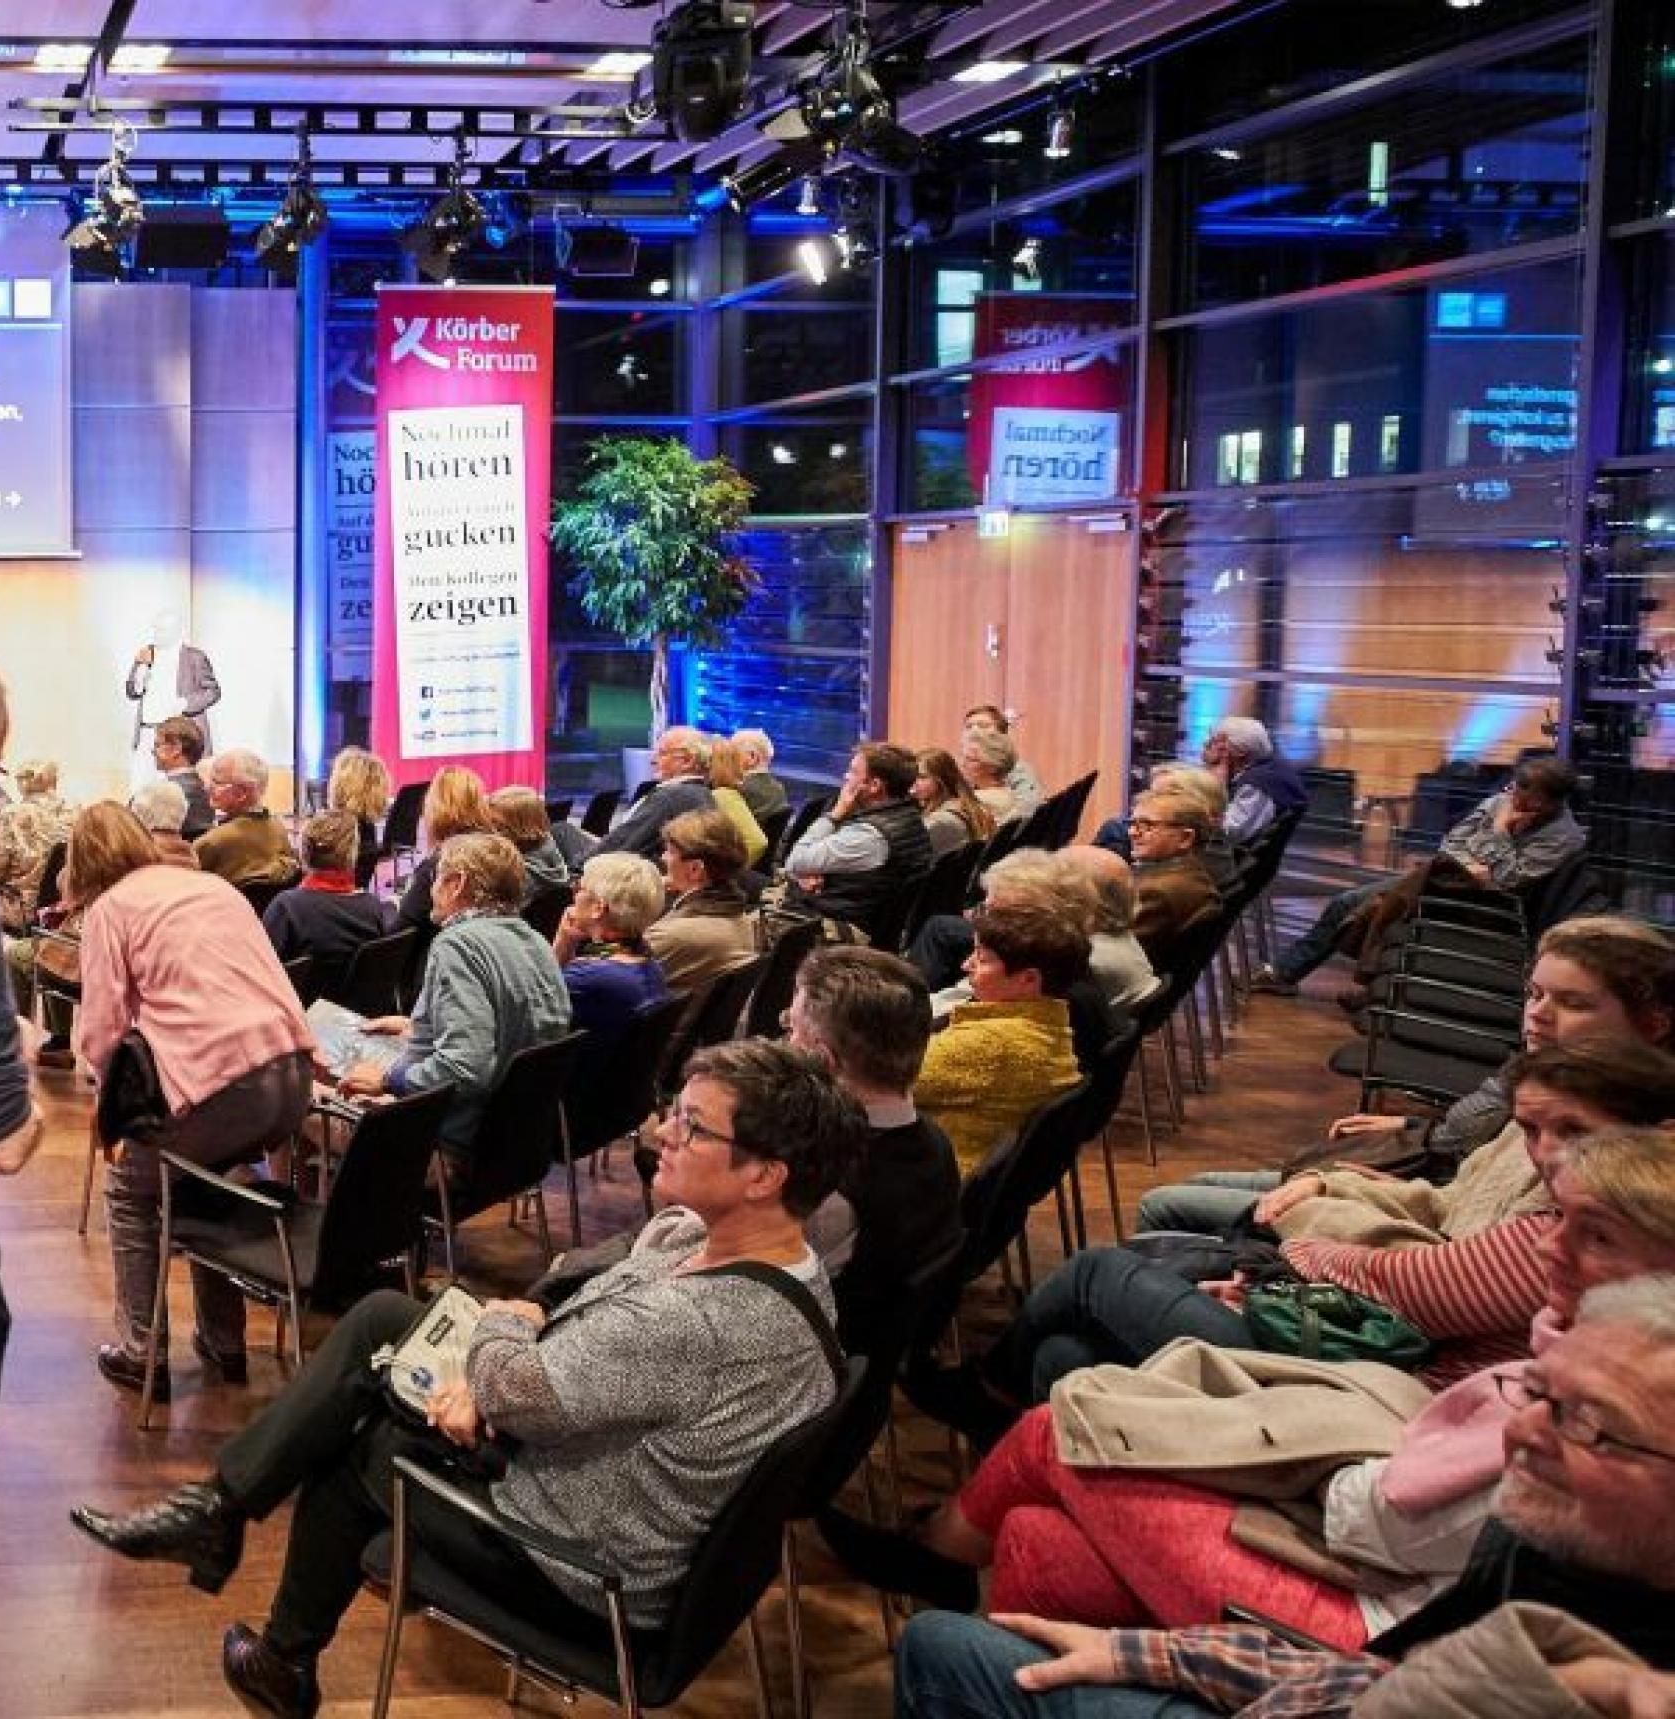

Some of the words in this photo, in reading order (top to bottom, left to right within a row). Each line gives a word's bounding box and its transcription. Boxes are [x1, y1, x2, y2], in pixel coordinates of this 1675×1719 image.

[435, 317, 522, 342] Körber
[457, 348, 538, 372] Forum
[404, 451, 513, 481] hören
[404, 521, 515, 556] gucken
[408, 591, 518, 626] zeigen
